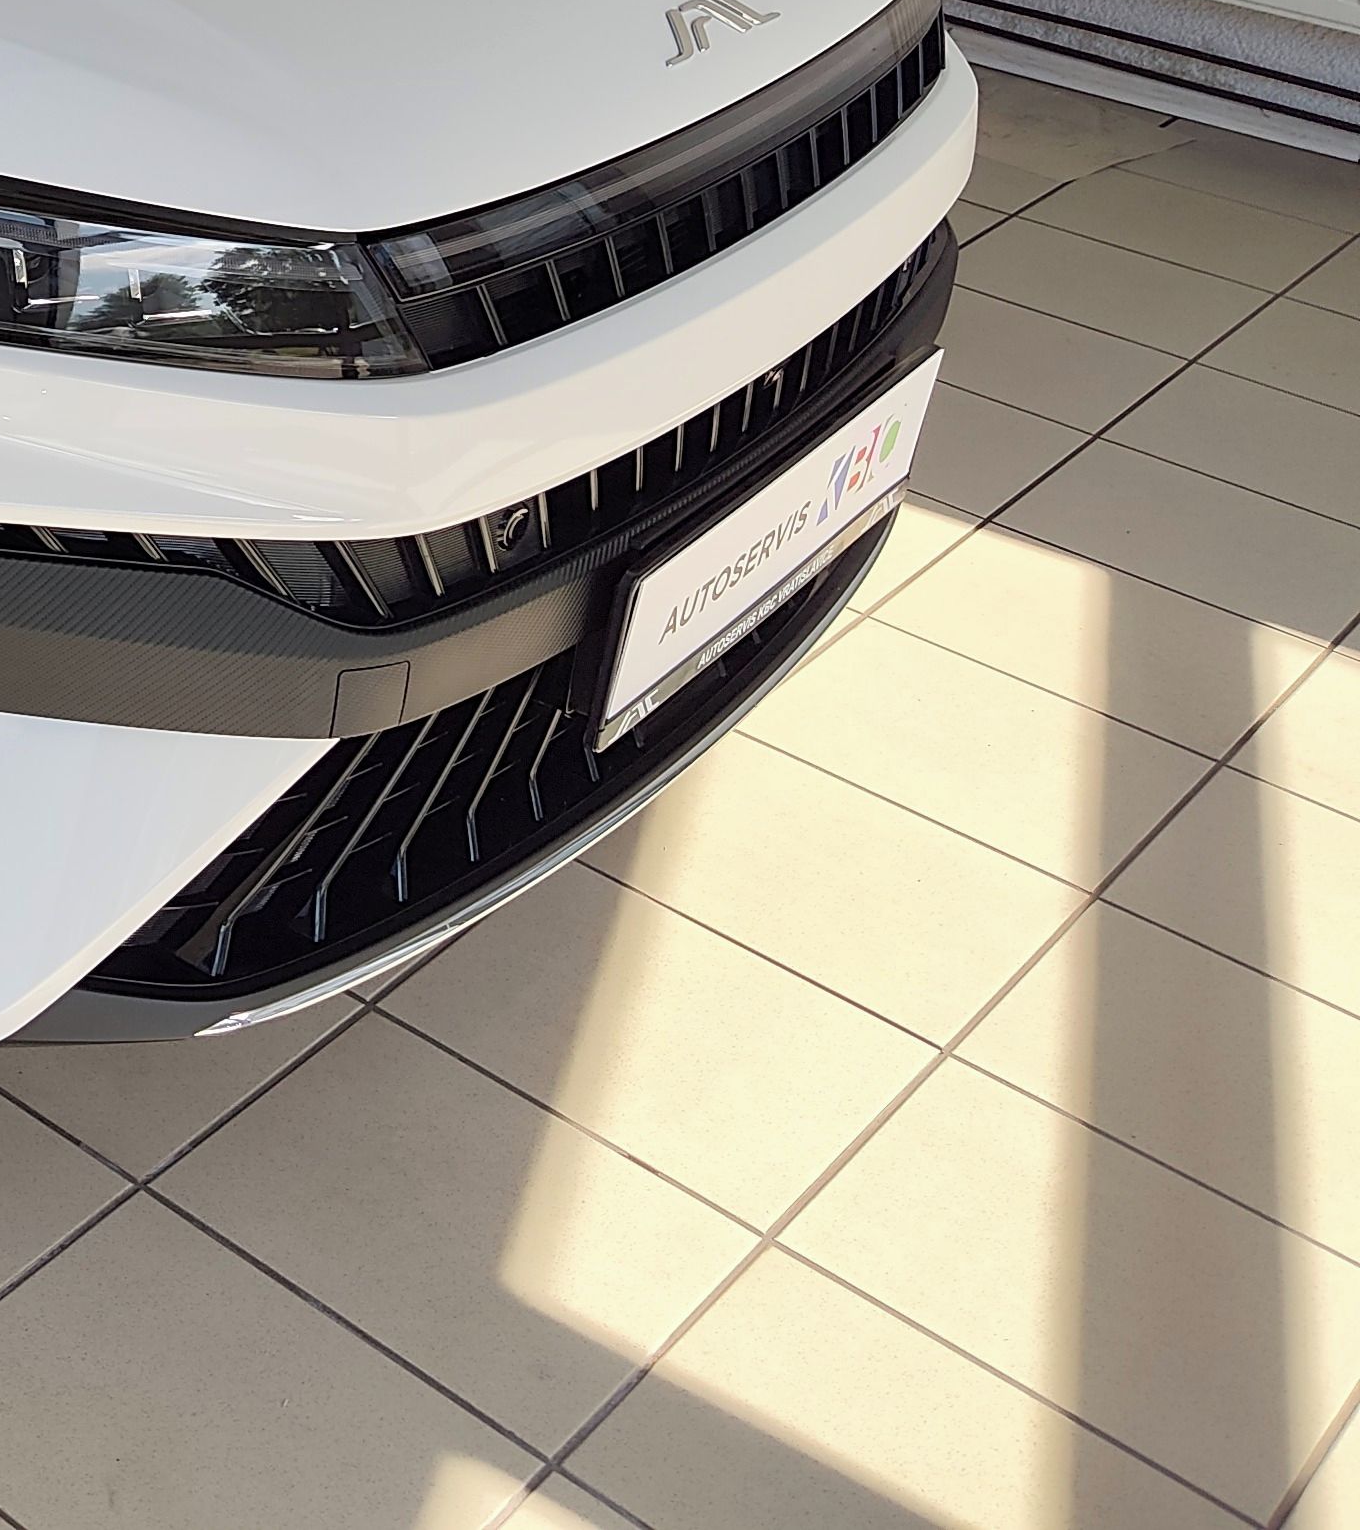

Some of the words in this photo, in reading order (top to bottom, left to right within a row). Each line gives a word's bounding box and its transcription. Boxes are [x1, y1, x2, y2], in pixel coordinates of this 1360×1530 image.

[658, 500, 812, 645] AUTOSERVIS
[696, 611, 759, 670] AUTOSERVIS
[756, 595, 779, 621] KBC
